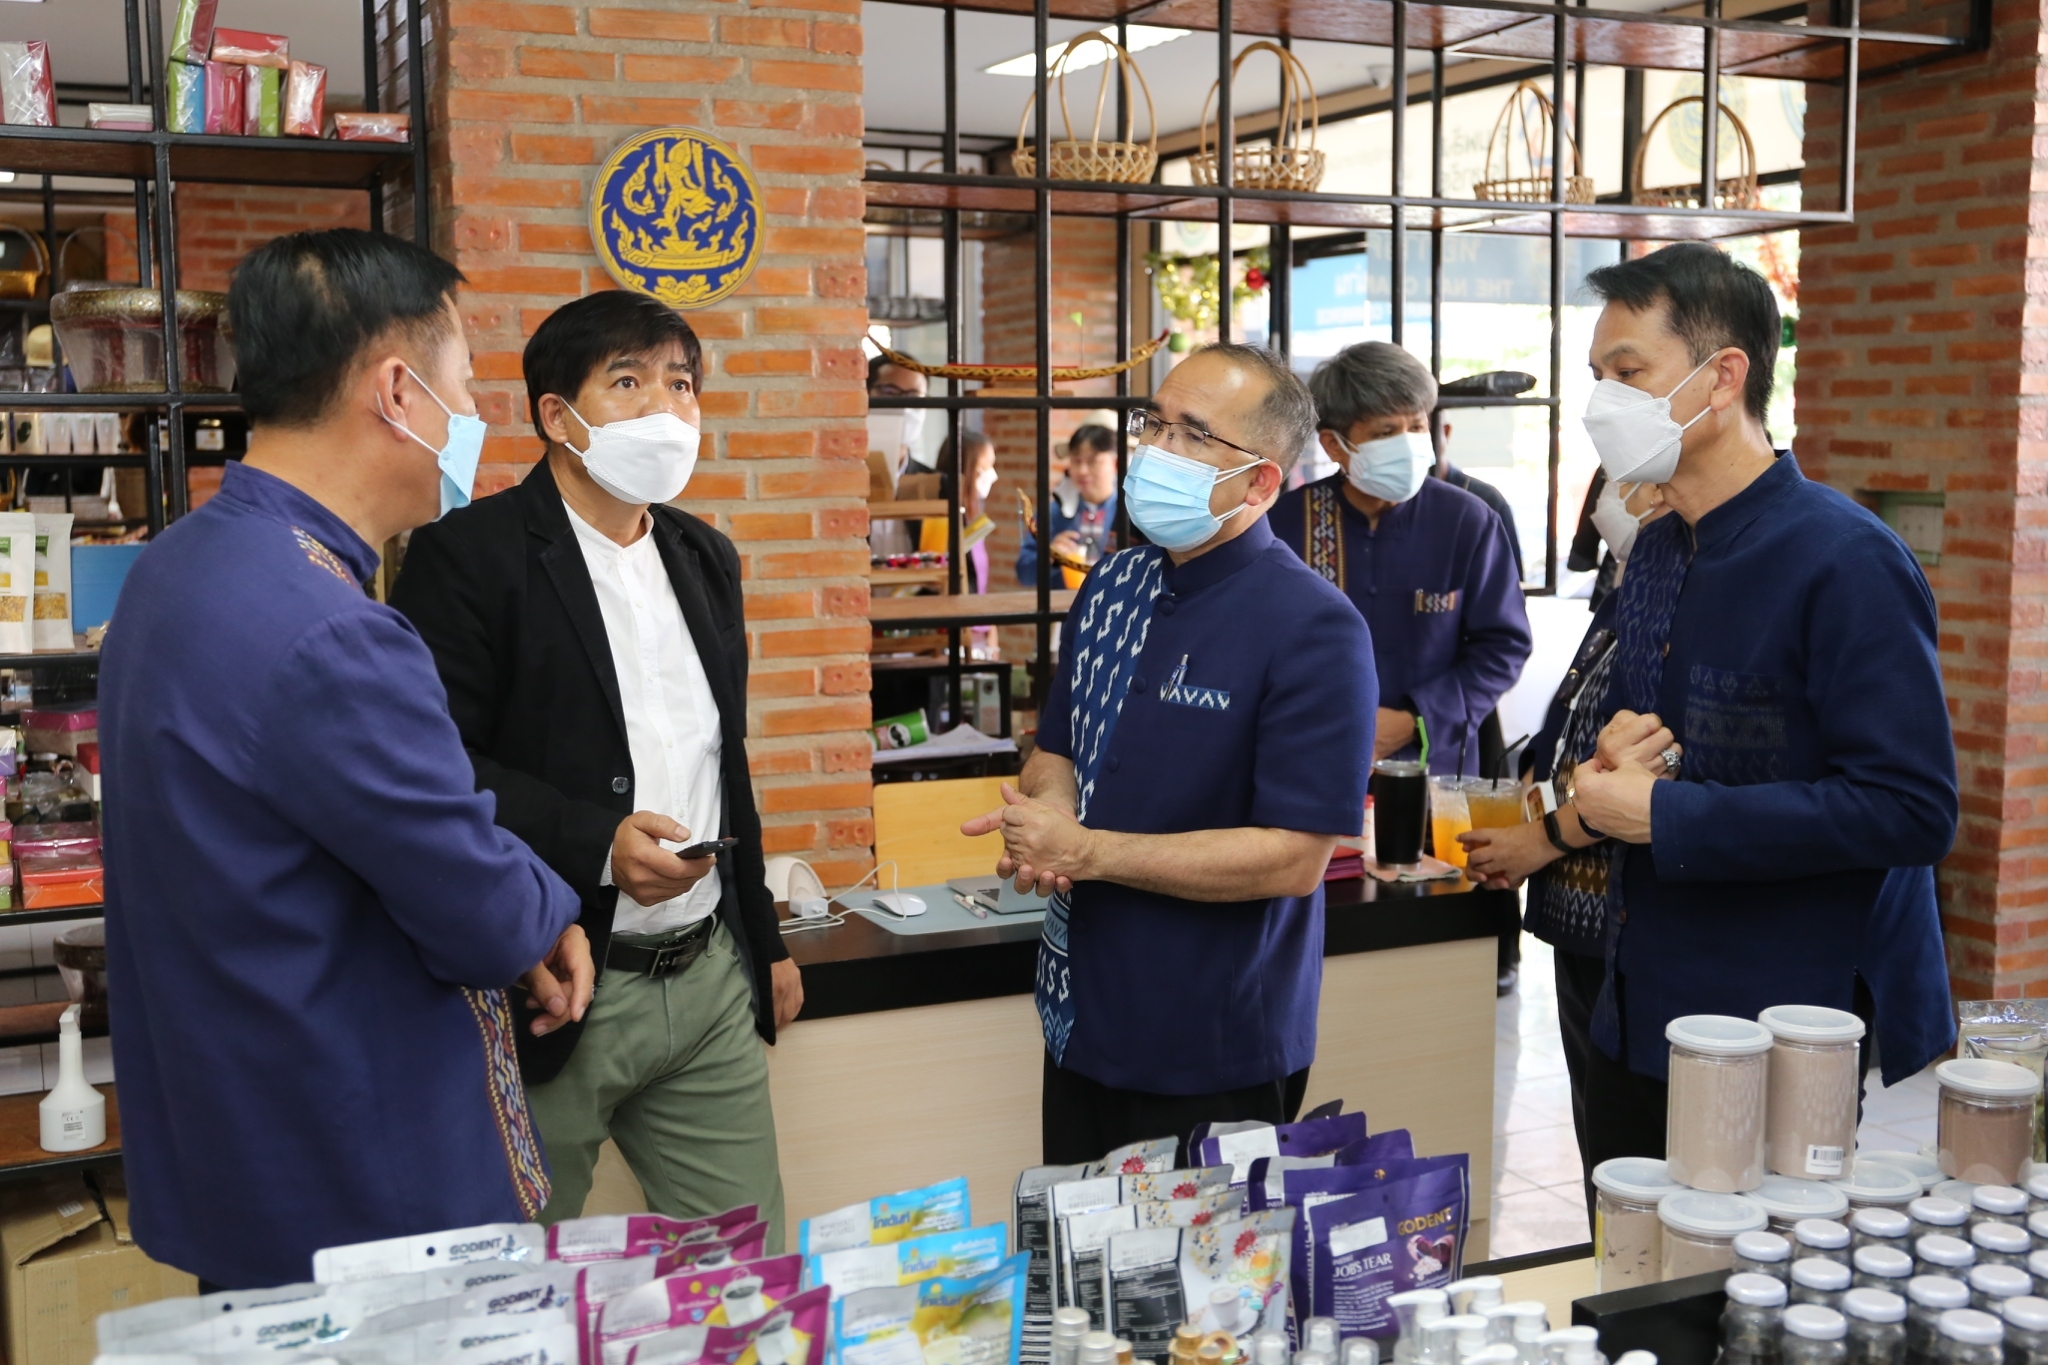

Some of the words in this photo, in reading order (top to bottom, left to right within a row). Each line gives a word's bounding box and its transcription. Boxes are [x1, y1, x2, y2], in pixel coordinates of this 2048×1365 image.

[1397, 1207, 1452, 1236] GODENT
[450, 1237, 502, 1255] GODENT
[1362, 1252, 1393, 1270] TEAR
[488, 1288, 542, 1310] GODENT
